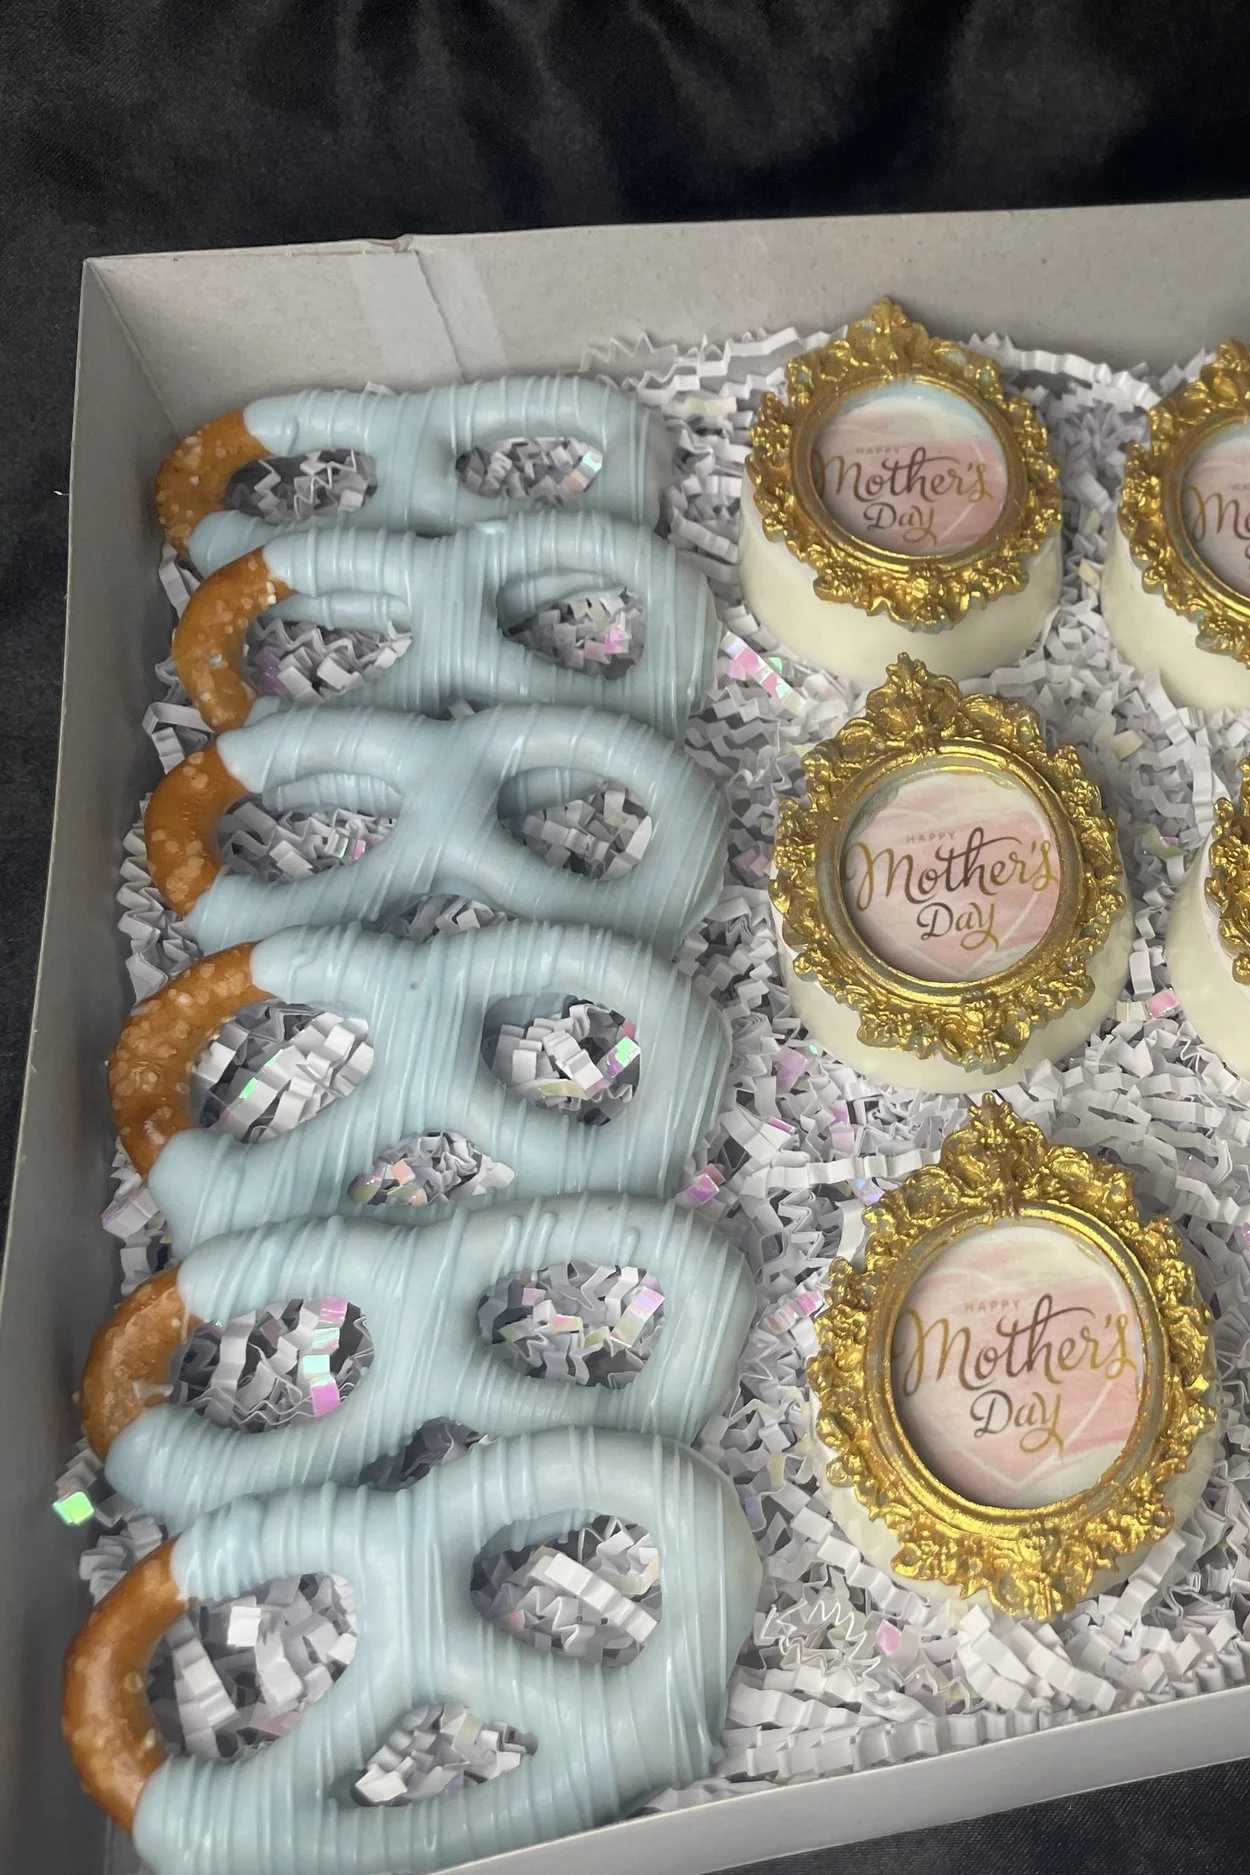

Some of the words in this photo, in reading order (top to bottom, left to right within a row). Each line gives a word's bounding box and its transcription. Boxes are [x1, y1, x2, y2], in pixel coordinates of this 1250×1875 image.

[822, 446, 993, 503] Mother's
[862, 502, 938, 546] Day
[905, 831, 956, 844] HAPPY
[848, 826, 1060, 911] Mother's
[916, 902, 1000, 952] Day
[963, 1298, 1021, 1314] HAPPY
[900, 1293, 1138, 1397] Mother's
[970, 1389, 1065, 1453] Day
